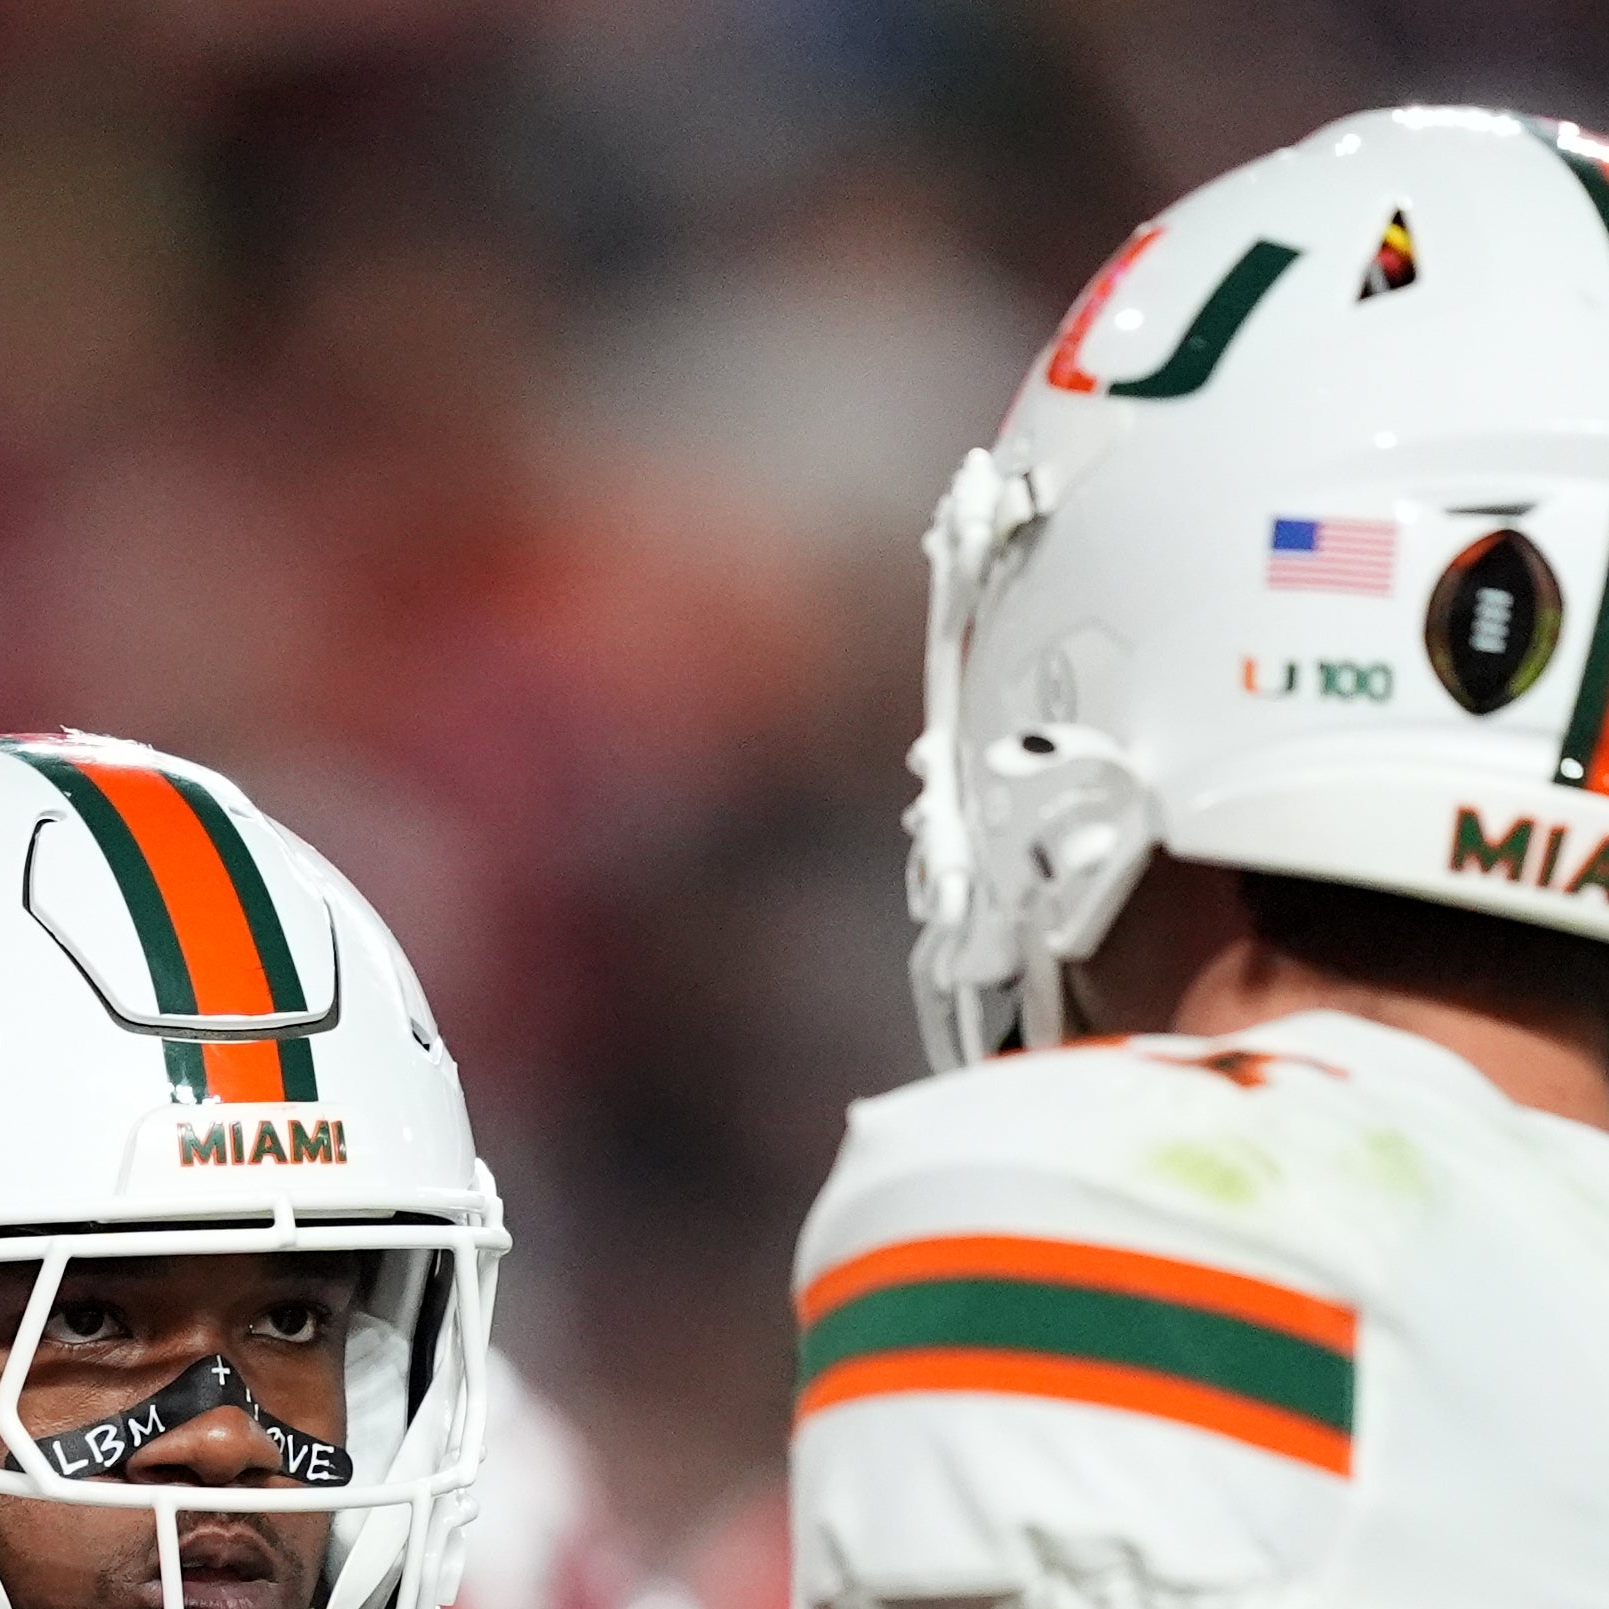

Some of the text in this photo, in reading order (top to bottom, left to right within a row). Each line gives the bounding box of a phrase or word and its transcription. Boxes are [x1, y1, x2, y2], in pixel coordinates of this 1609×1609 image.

[1317, 660, 1394, 701] 100
[177, 1119, 347, 1167] MIAMI
[52, 1405, 166, 1475] LBM
